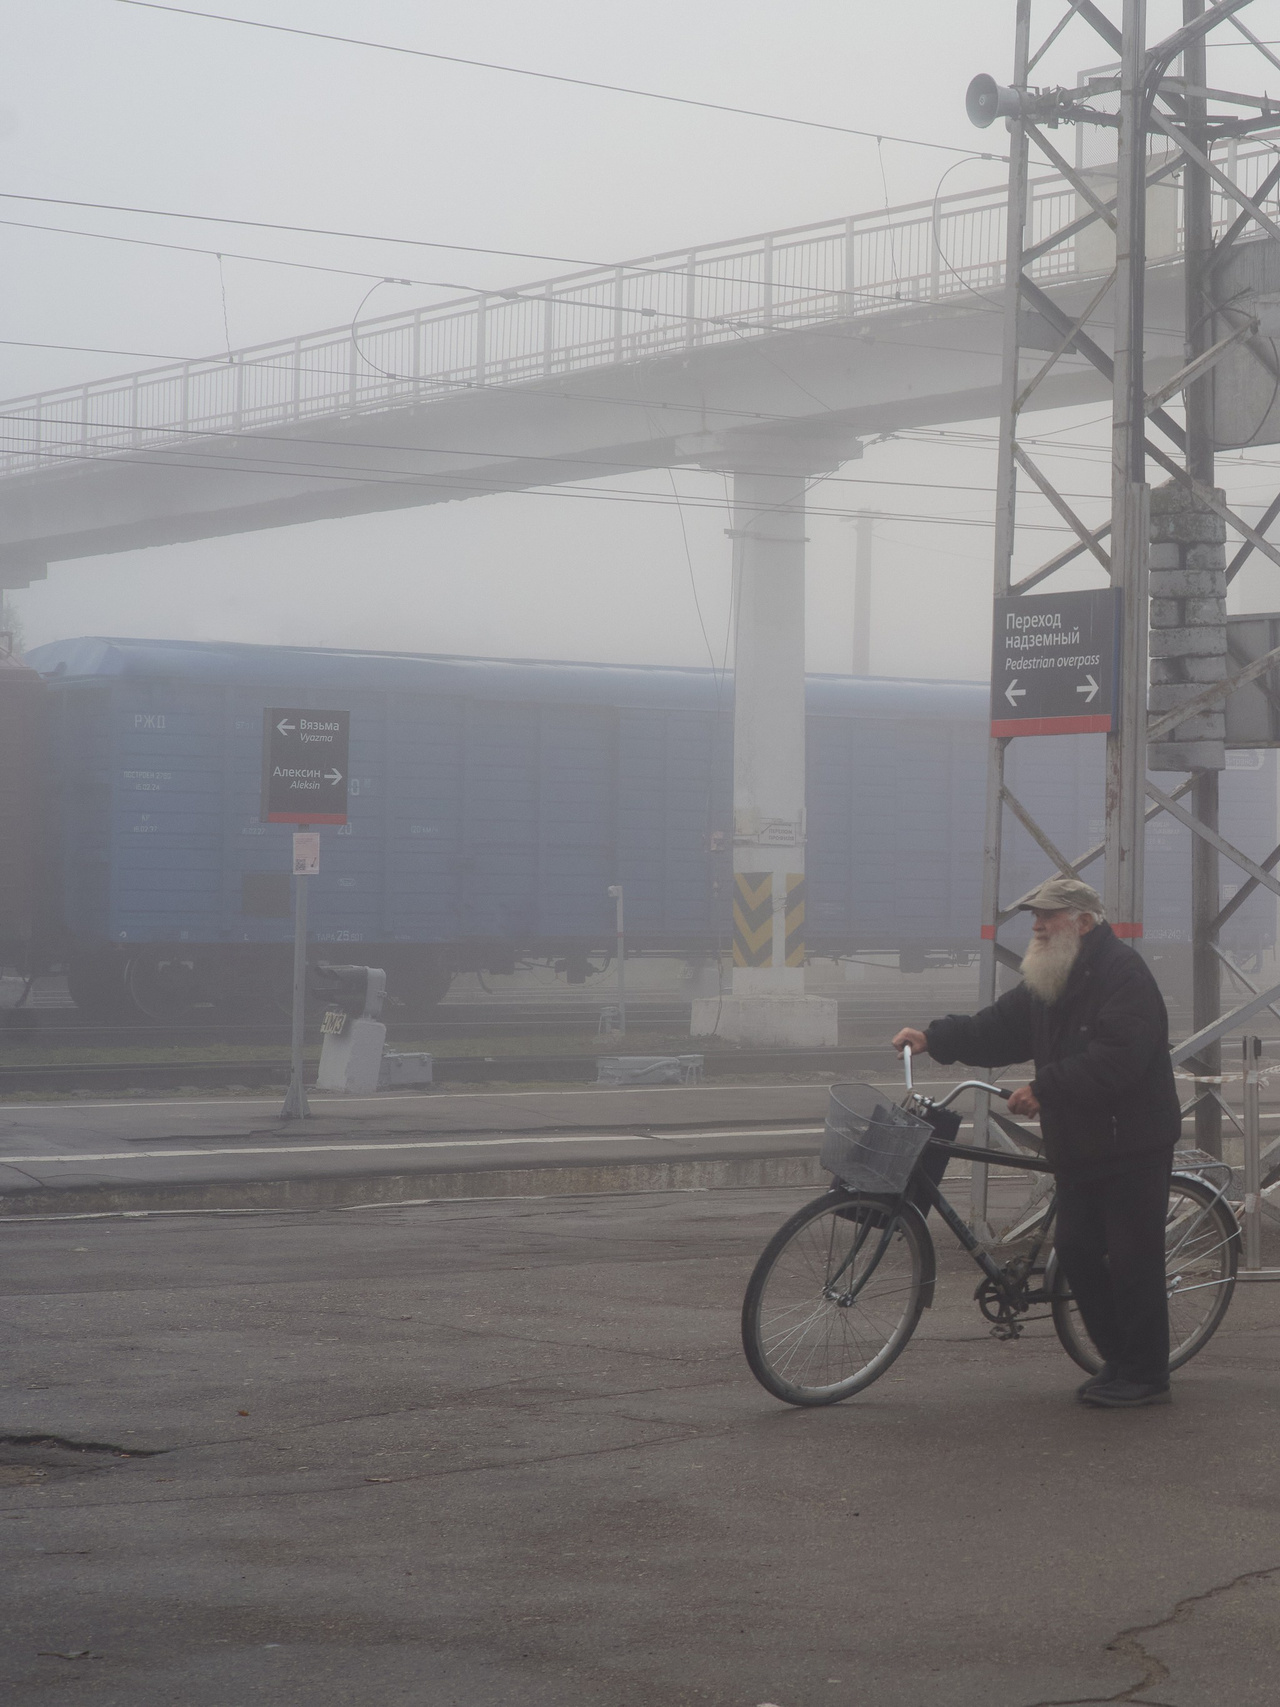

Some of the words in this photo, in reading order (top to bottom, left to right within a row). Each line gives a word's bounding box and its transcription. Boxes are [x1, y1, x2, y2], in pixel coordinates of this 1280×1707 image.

[1005, 612, 1062, 633] Переход
[1005, 626, 1081, 651] надземный
[1005, 655, 1055, 671] Pedestrian
[1056, 654, 1101, 670] overpass
[134, 714, 166, 729] РЖД
[299, 718, 340, 731] Вязьма
[299, 732, 334, 744] Vyazma
[272, 765, 322, 778] Алексин
[289, 780, 321, 790] Aleksin
